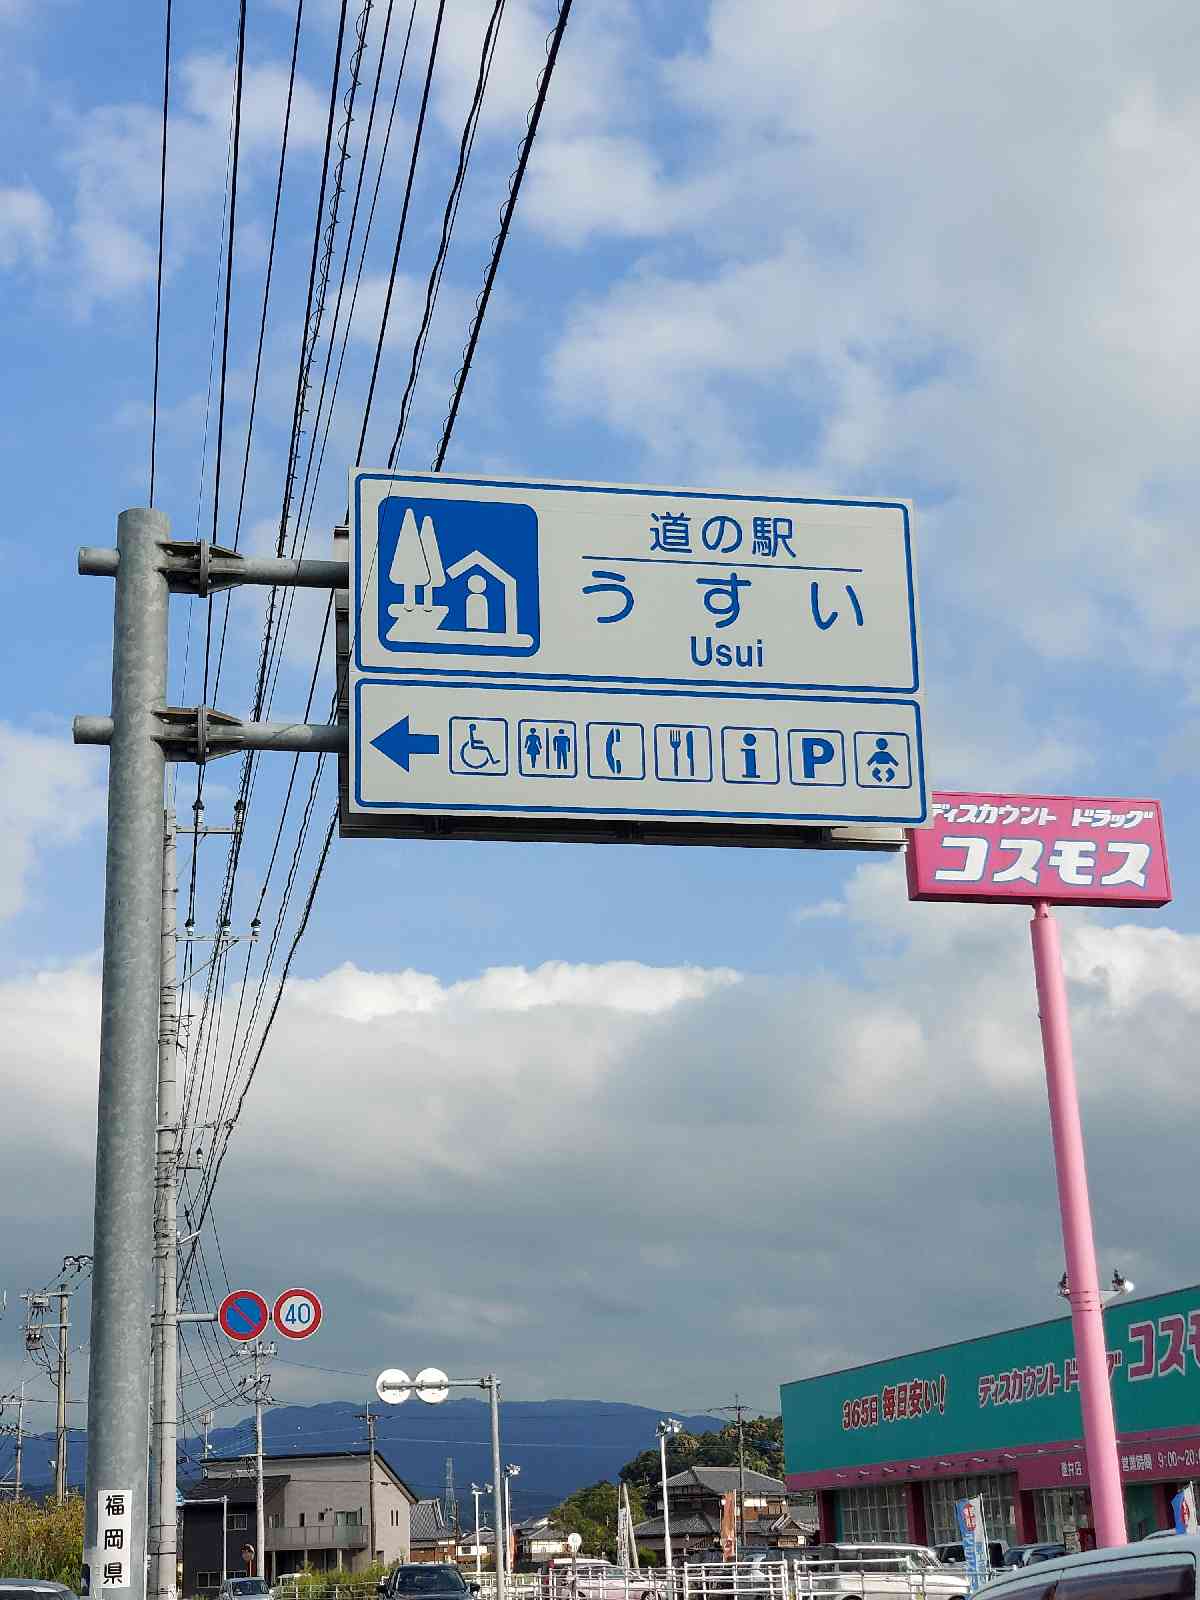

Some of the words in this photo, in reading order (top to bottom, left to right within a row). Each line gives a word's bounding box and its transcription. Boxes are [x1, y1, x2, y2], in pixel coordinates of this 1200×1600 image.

[650, 512, 796, 557] 道の駅
[582, 570, 864, 631] うすい
[690, 635, 764, 668] Usui
[931, 802, 1056, 826] ディスカウント
[1071, 808, 1154, 828] ドラッグ
[934, 836, 1150, 888] コスモス
[285, 1303, 311, 1325] 40
[978, 1361, 1062, 1408] ディスカウント
[842, 1395, 879, 1431] 365日
[103, 1494, 125, 1585] 福岡県
